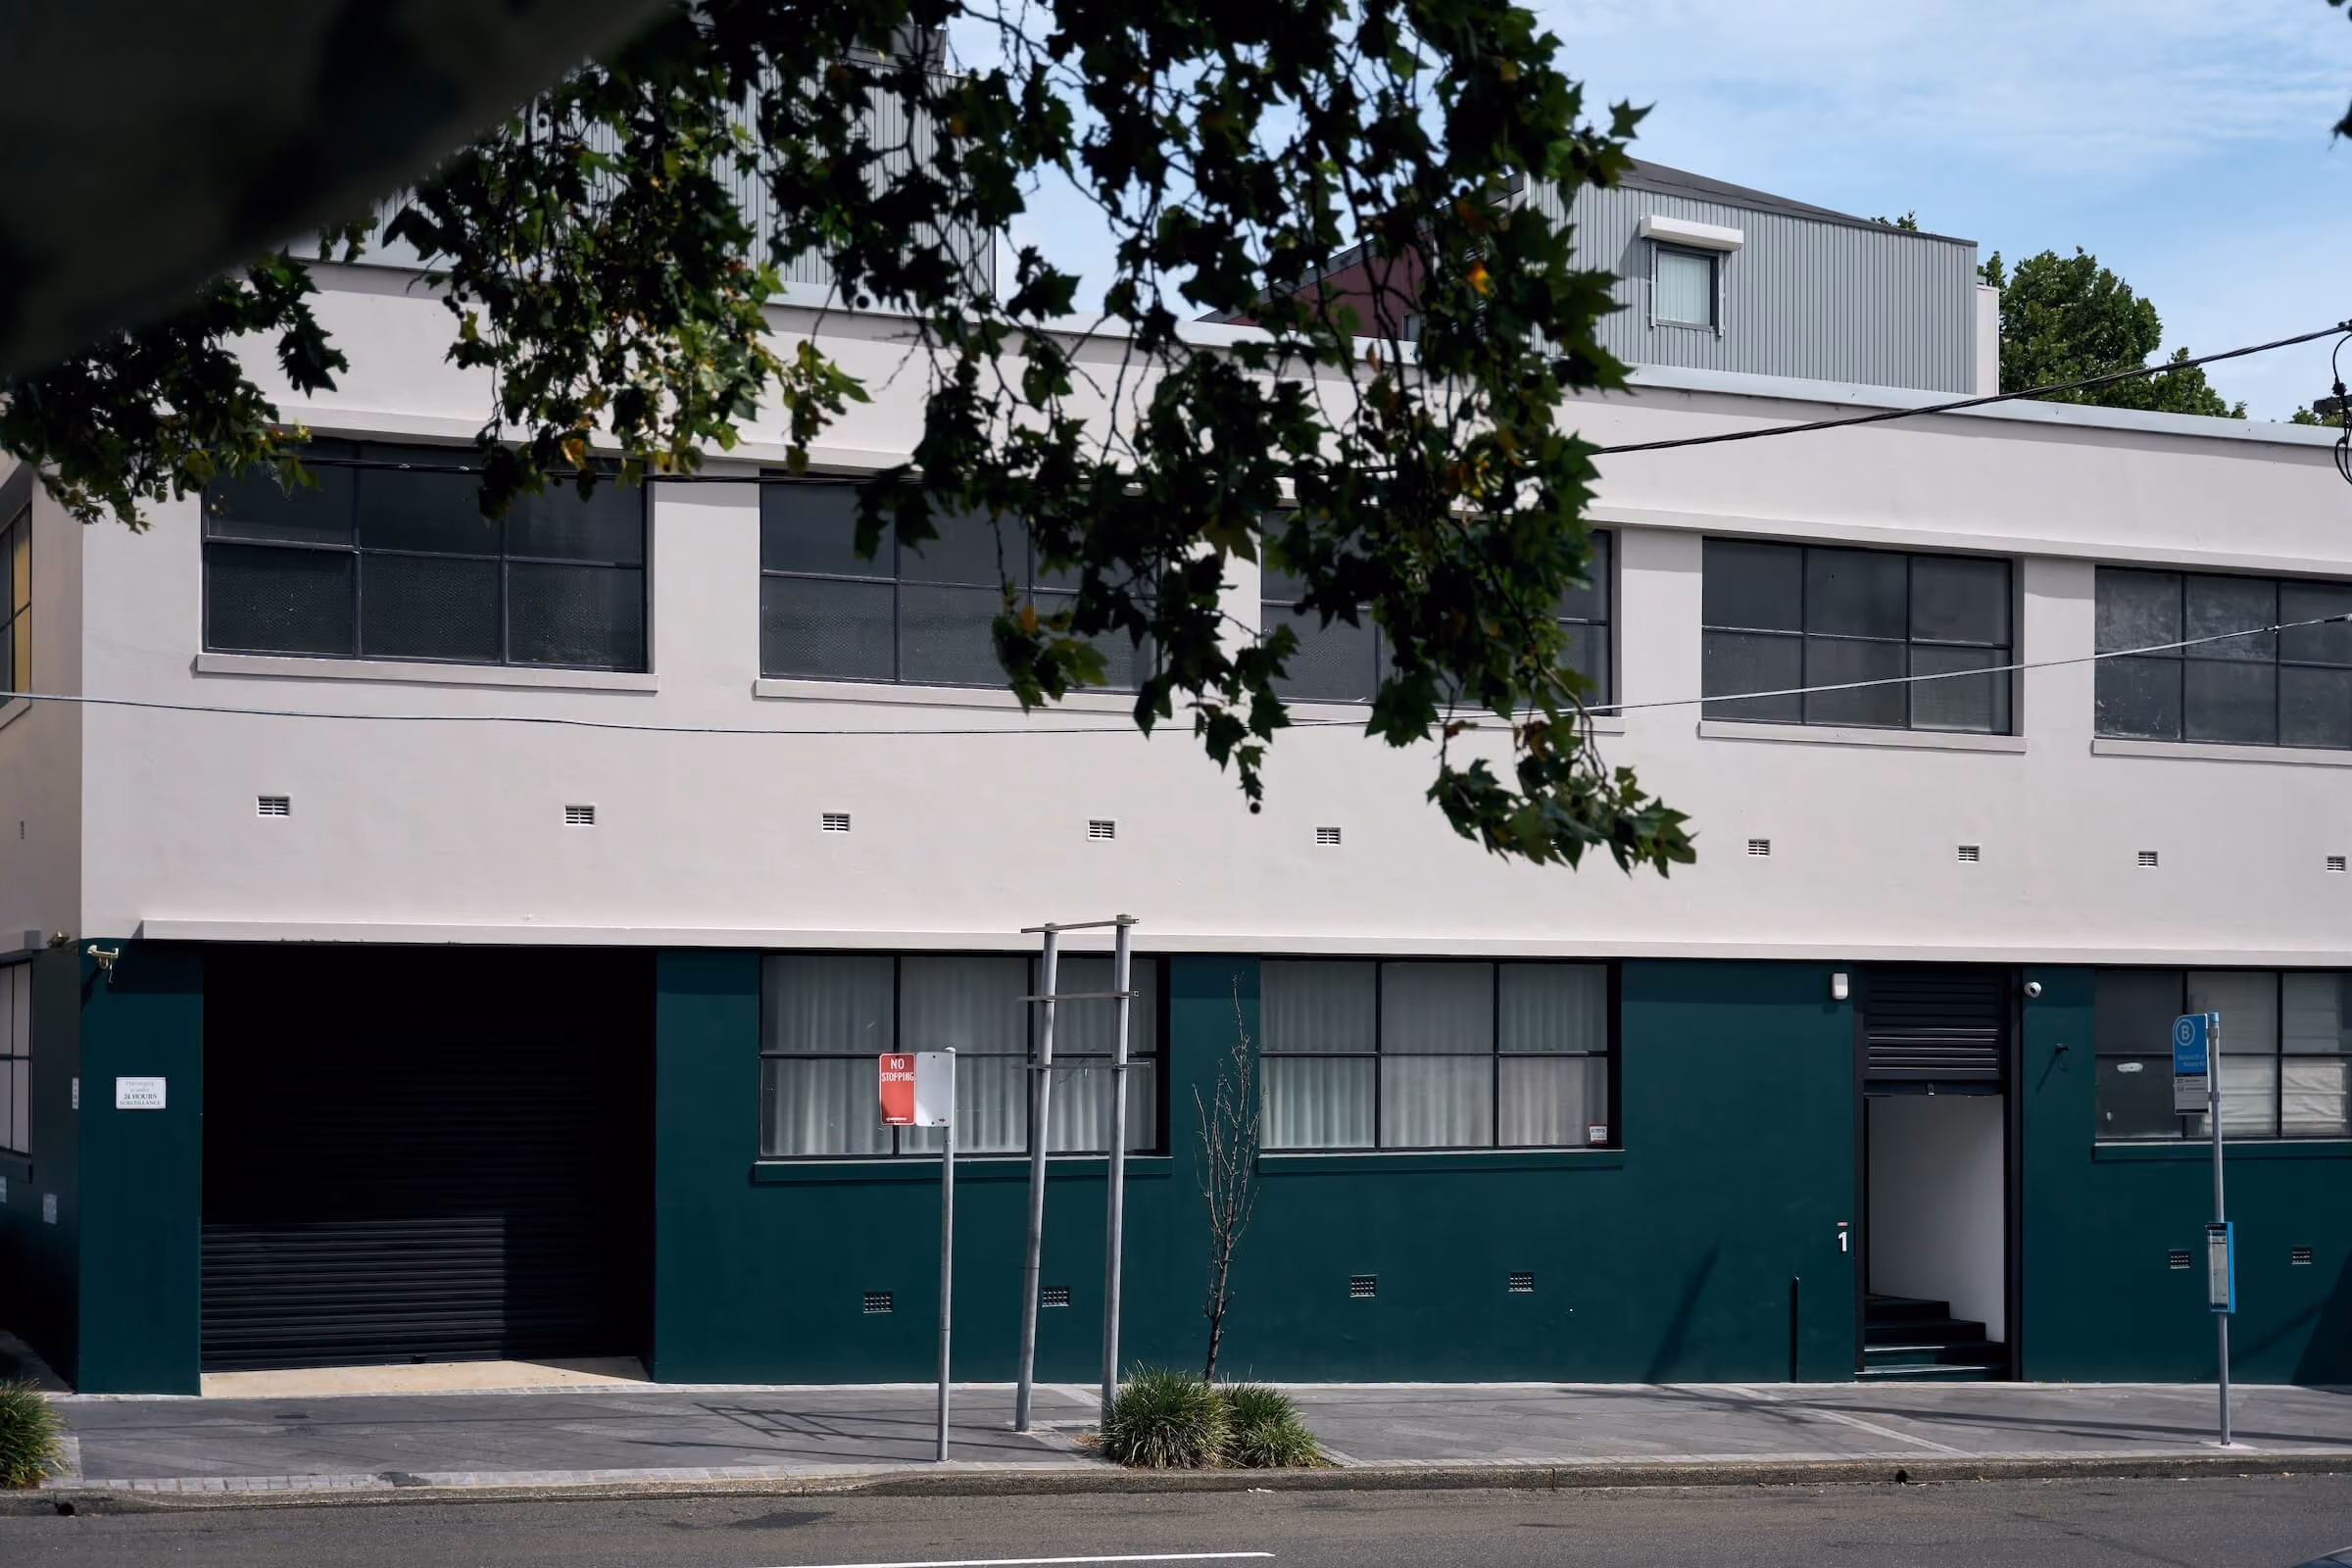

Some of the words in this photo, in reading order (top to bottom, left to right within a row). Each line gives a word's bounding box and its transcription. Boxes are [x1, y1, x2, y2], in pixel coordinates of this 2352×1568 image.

[2180, 1024, 2190, 1041] B
[890, 1057, 906, 1070] NO
[881, 1072, 914, 1082] STOPPING
[1838, 1231, 1847, 1252] 1
